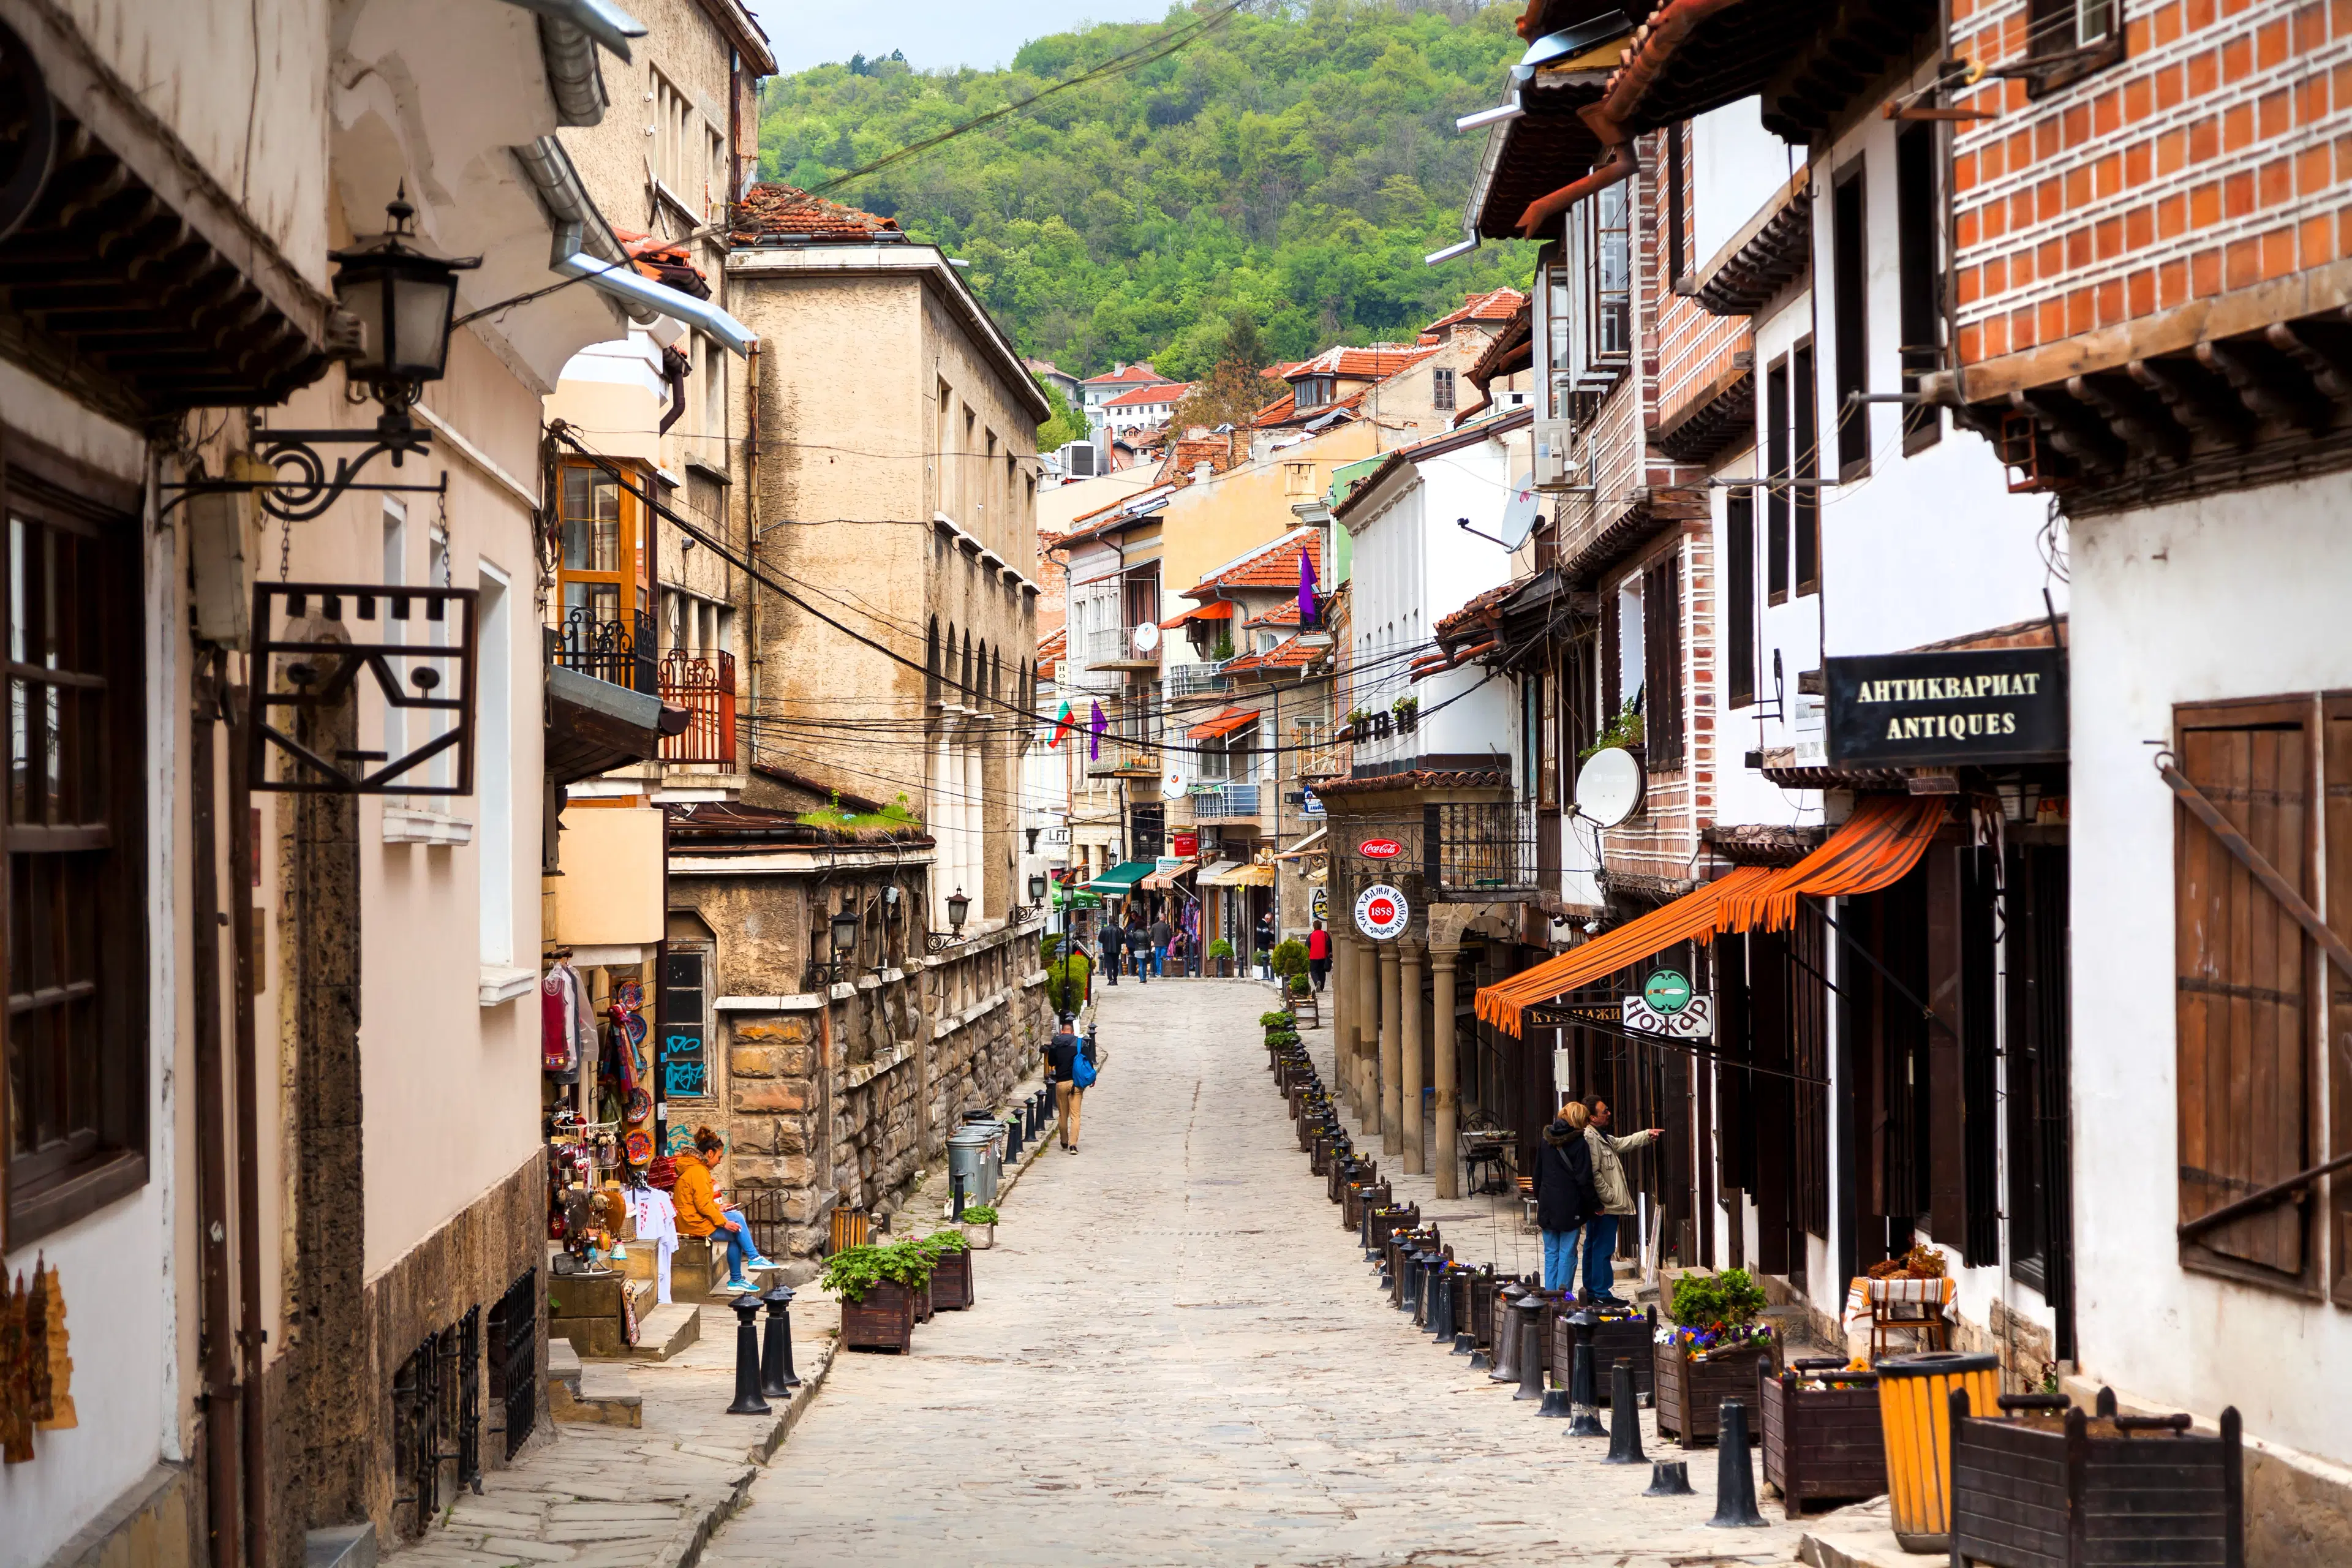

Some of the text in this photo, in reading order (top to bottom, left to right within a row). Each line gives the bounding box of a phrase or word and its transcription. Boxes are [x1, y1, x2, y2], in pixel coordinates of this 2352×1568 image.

[1856, 673, 2040, 703] АНТИКВАРИАТ
[1886, 713, 2016, 740] ANTIQUES
[1364, 844, 1396, 853] Coca-Cola
[1357, 888, 1406, 928] ХАН ХАДЖИ НИКОЛИ
[1371, 907, 1392, 916] 1858
